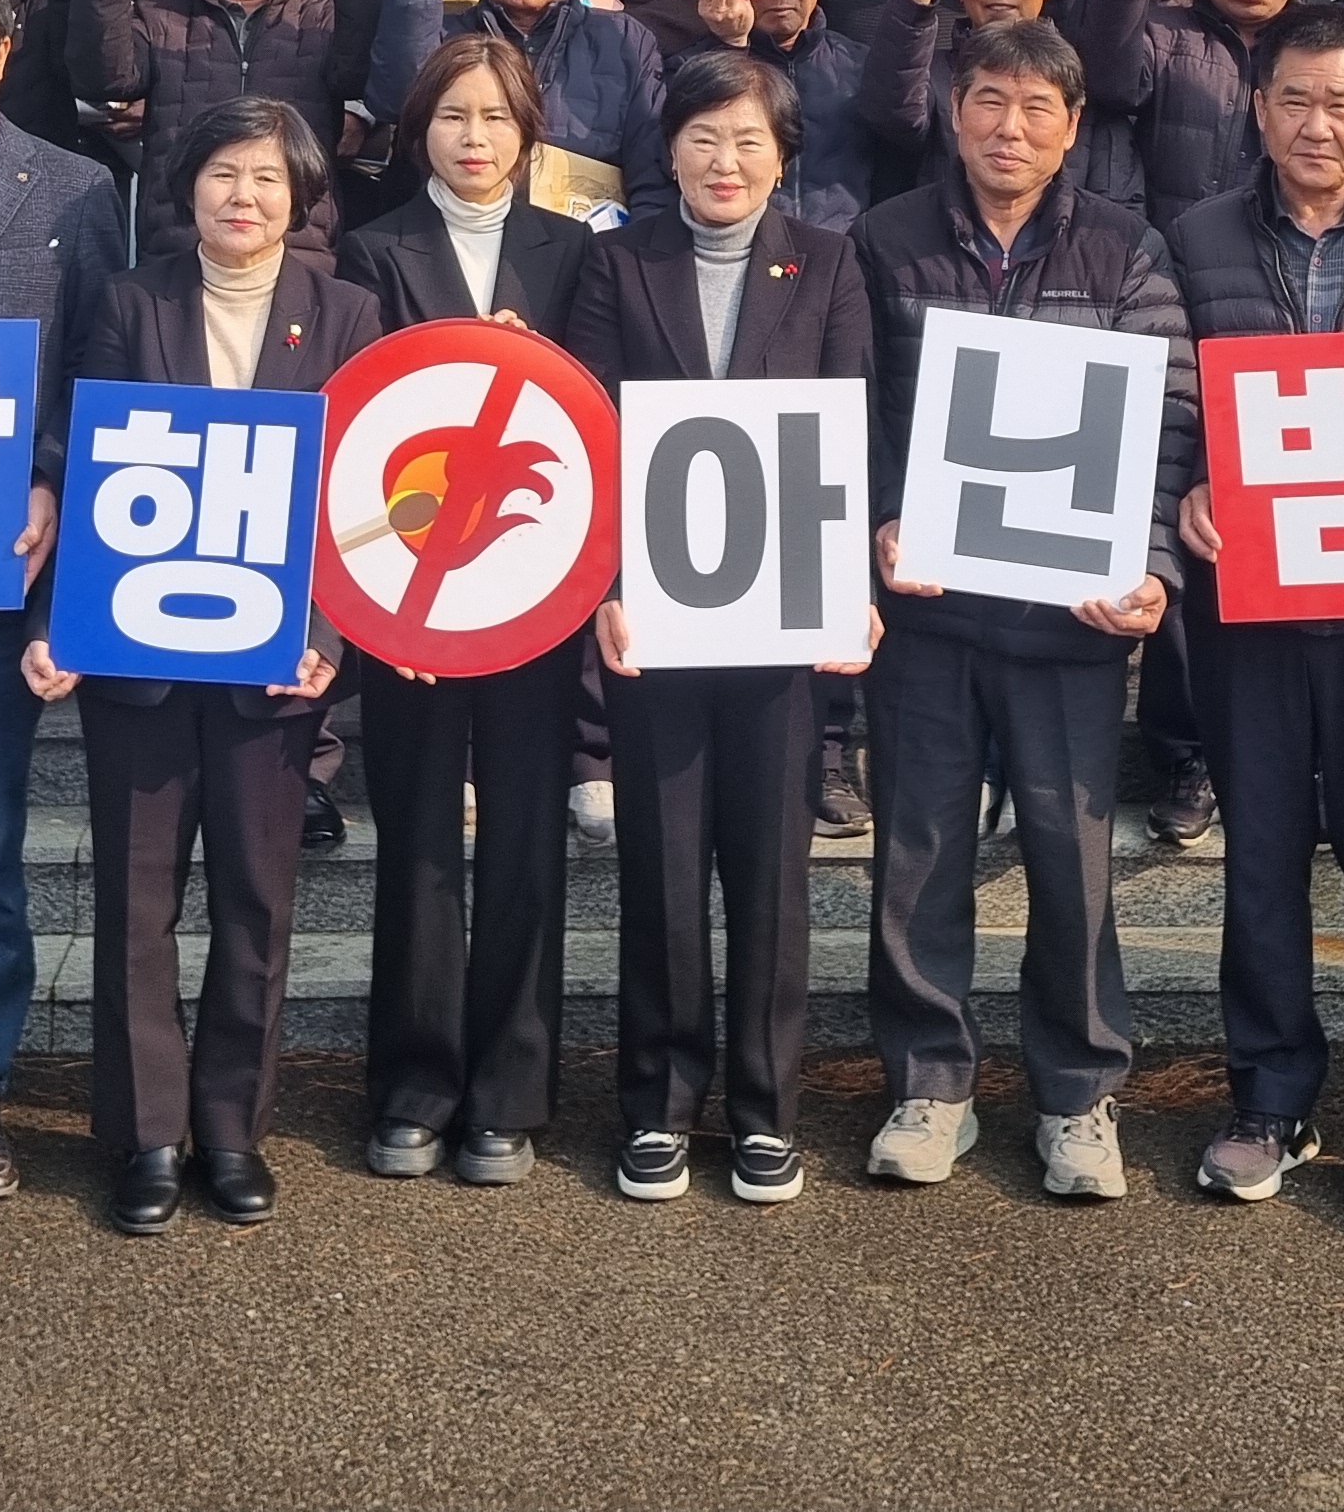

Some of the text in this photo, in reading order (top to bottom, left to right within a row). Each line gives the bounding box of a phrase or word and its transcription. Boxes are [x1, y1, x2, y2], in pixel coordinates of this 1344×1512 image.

[1042, 290, 1090, 298] MERRELL
[92, 410, 296, 652] 행
[645, 413, 846, 629] 아
[944, 347, 1128, 576] 닌
